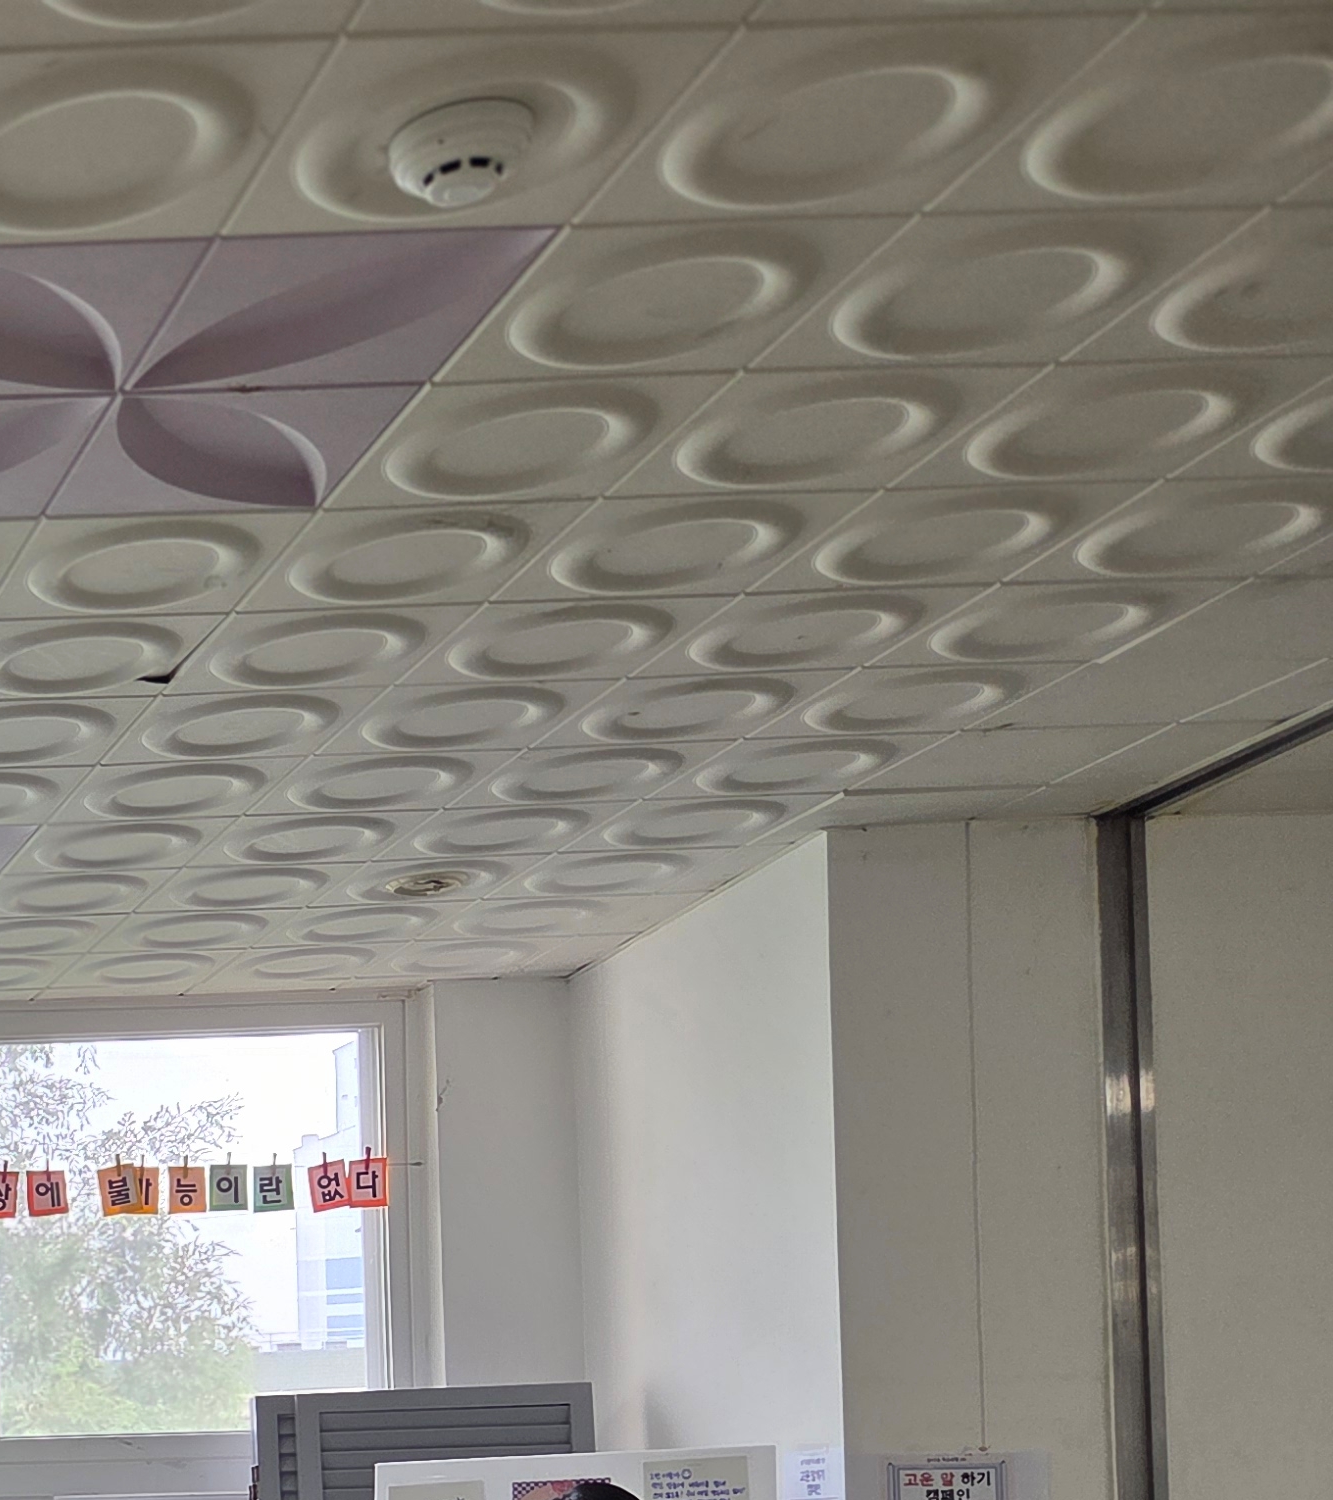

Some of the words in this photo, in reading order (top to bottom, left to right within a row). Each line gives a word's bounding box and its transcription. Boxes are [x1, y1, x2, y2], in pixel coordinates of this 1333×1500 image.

[316, 1169, 379, 1203] 없다
[903, 1471, 934, 1487] 고운
[940, 1471, 955, 1487] 말
[960, 1471, 992, 1487] 하기
